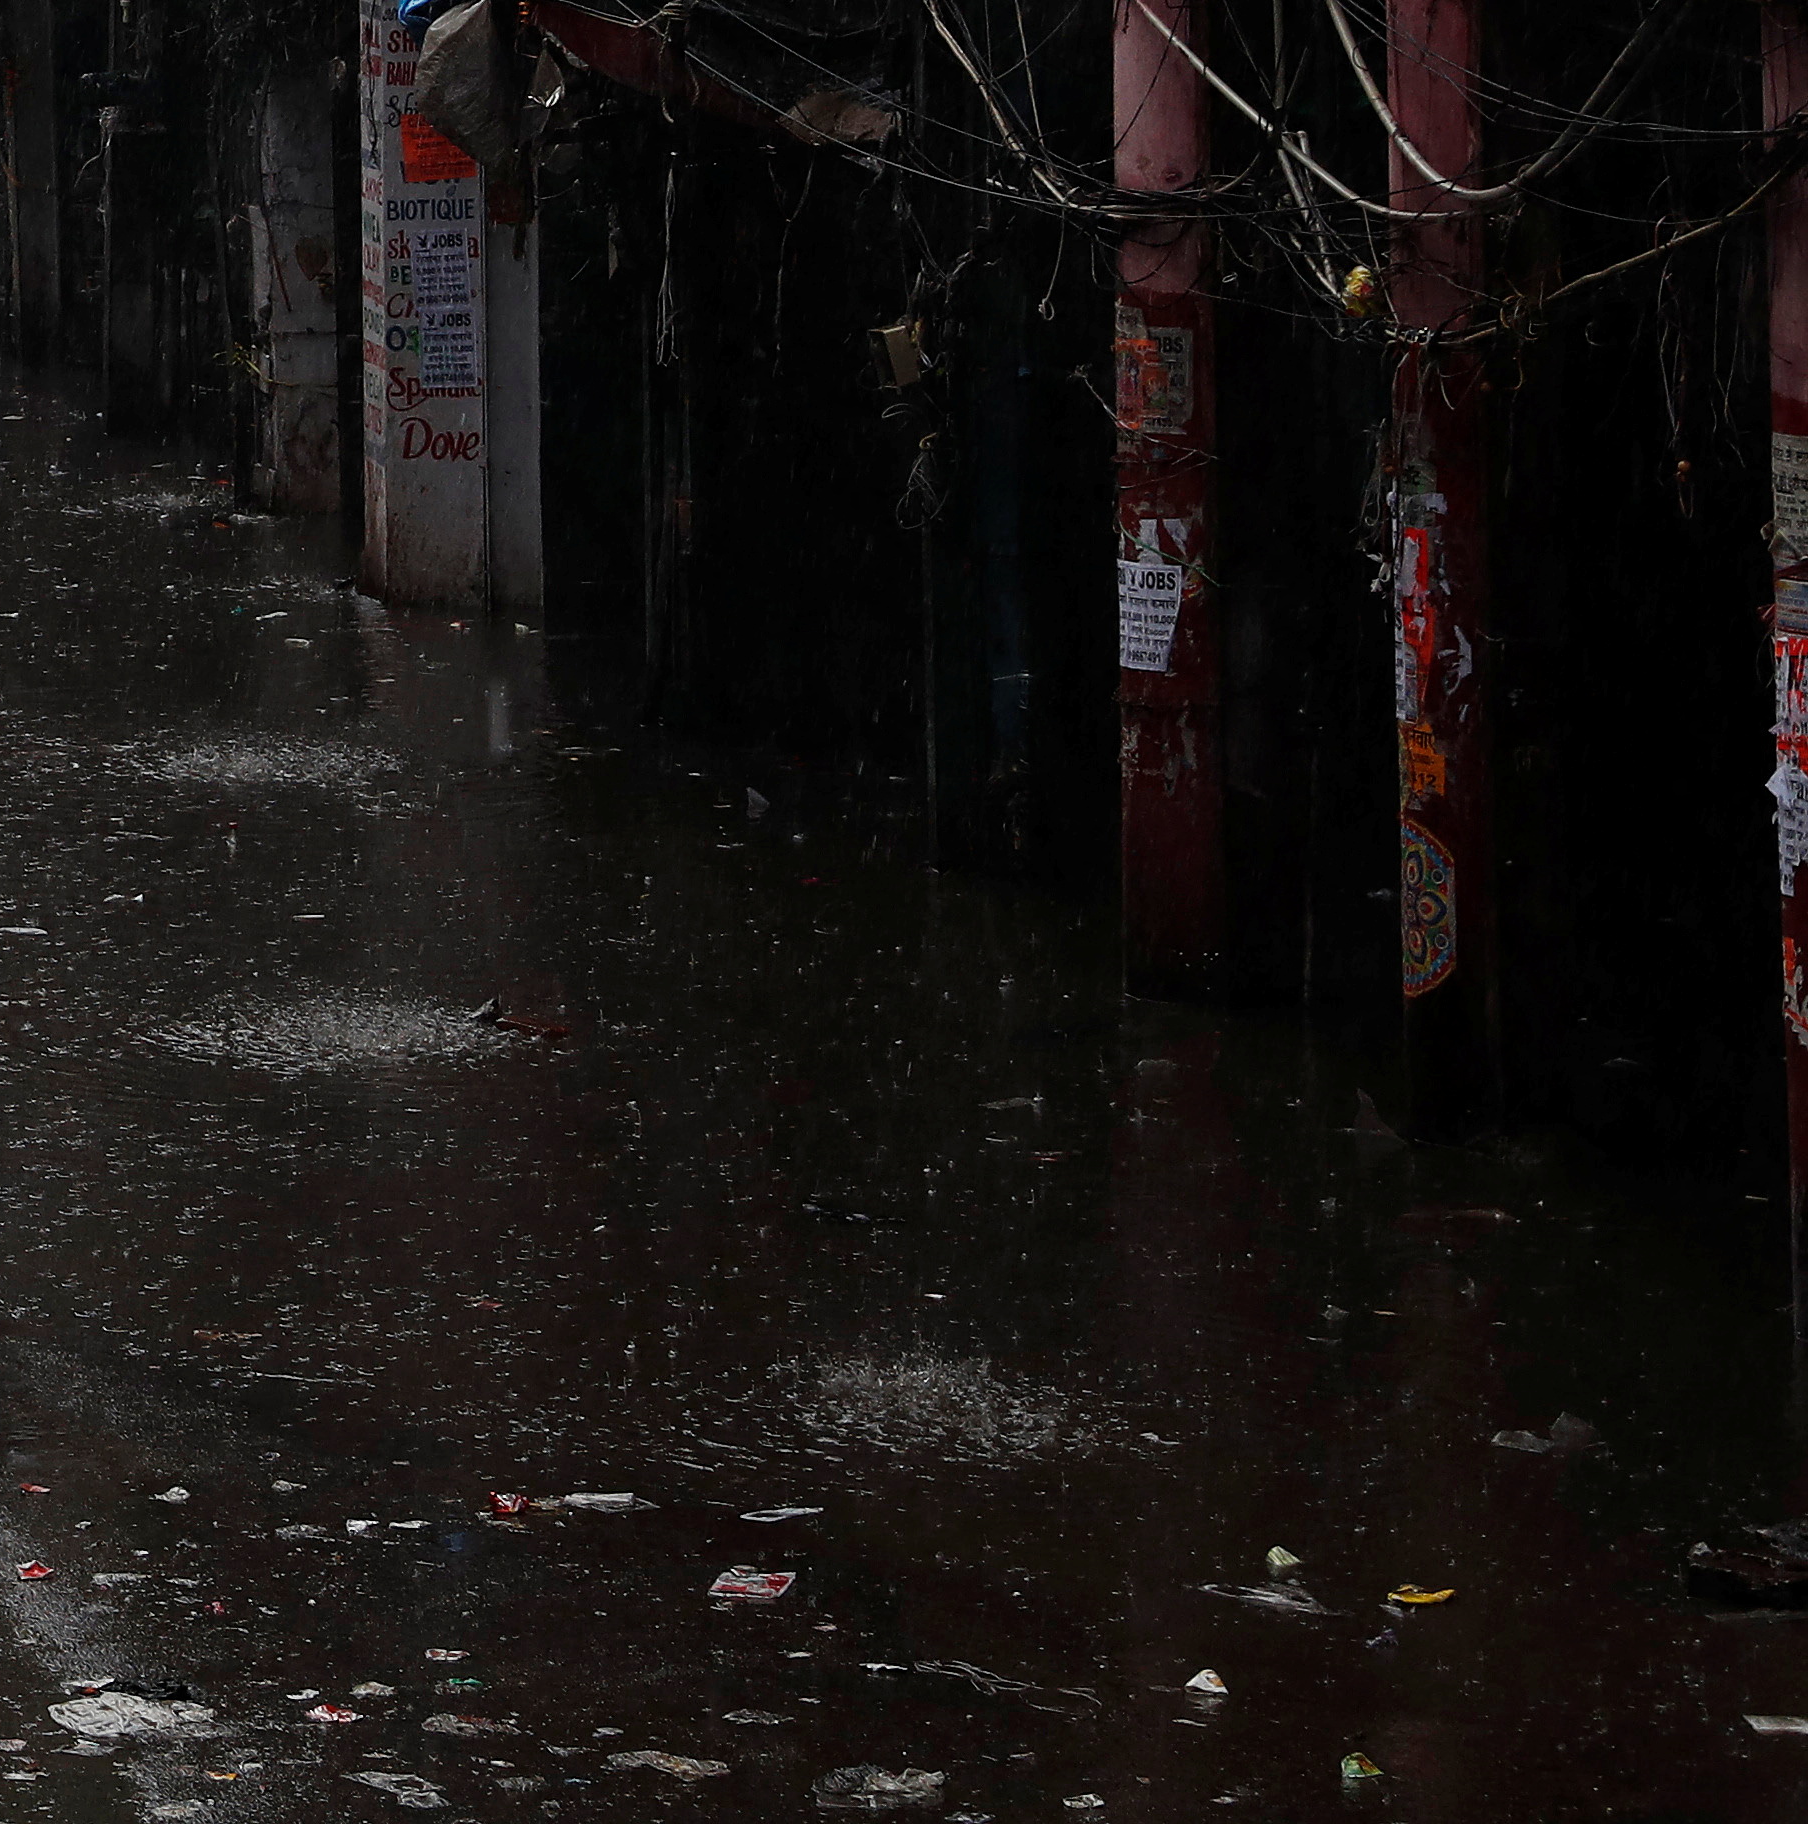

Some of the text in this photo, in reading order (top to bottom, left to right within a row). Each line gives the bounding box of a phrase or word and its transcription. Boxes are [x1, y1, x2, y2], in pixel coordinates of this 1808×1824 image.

[387, 198, 476, 222] BIOTIQUE
[431, 233, 464, 250] JOBS
[440, 313, 472, 328] JOBS
[399, 417, 481, 462] Dove
[1139, 570, 1176, 591] JOBS
